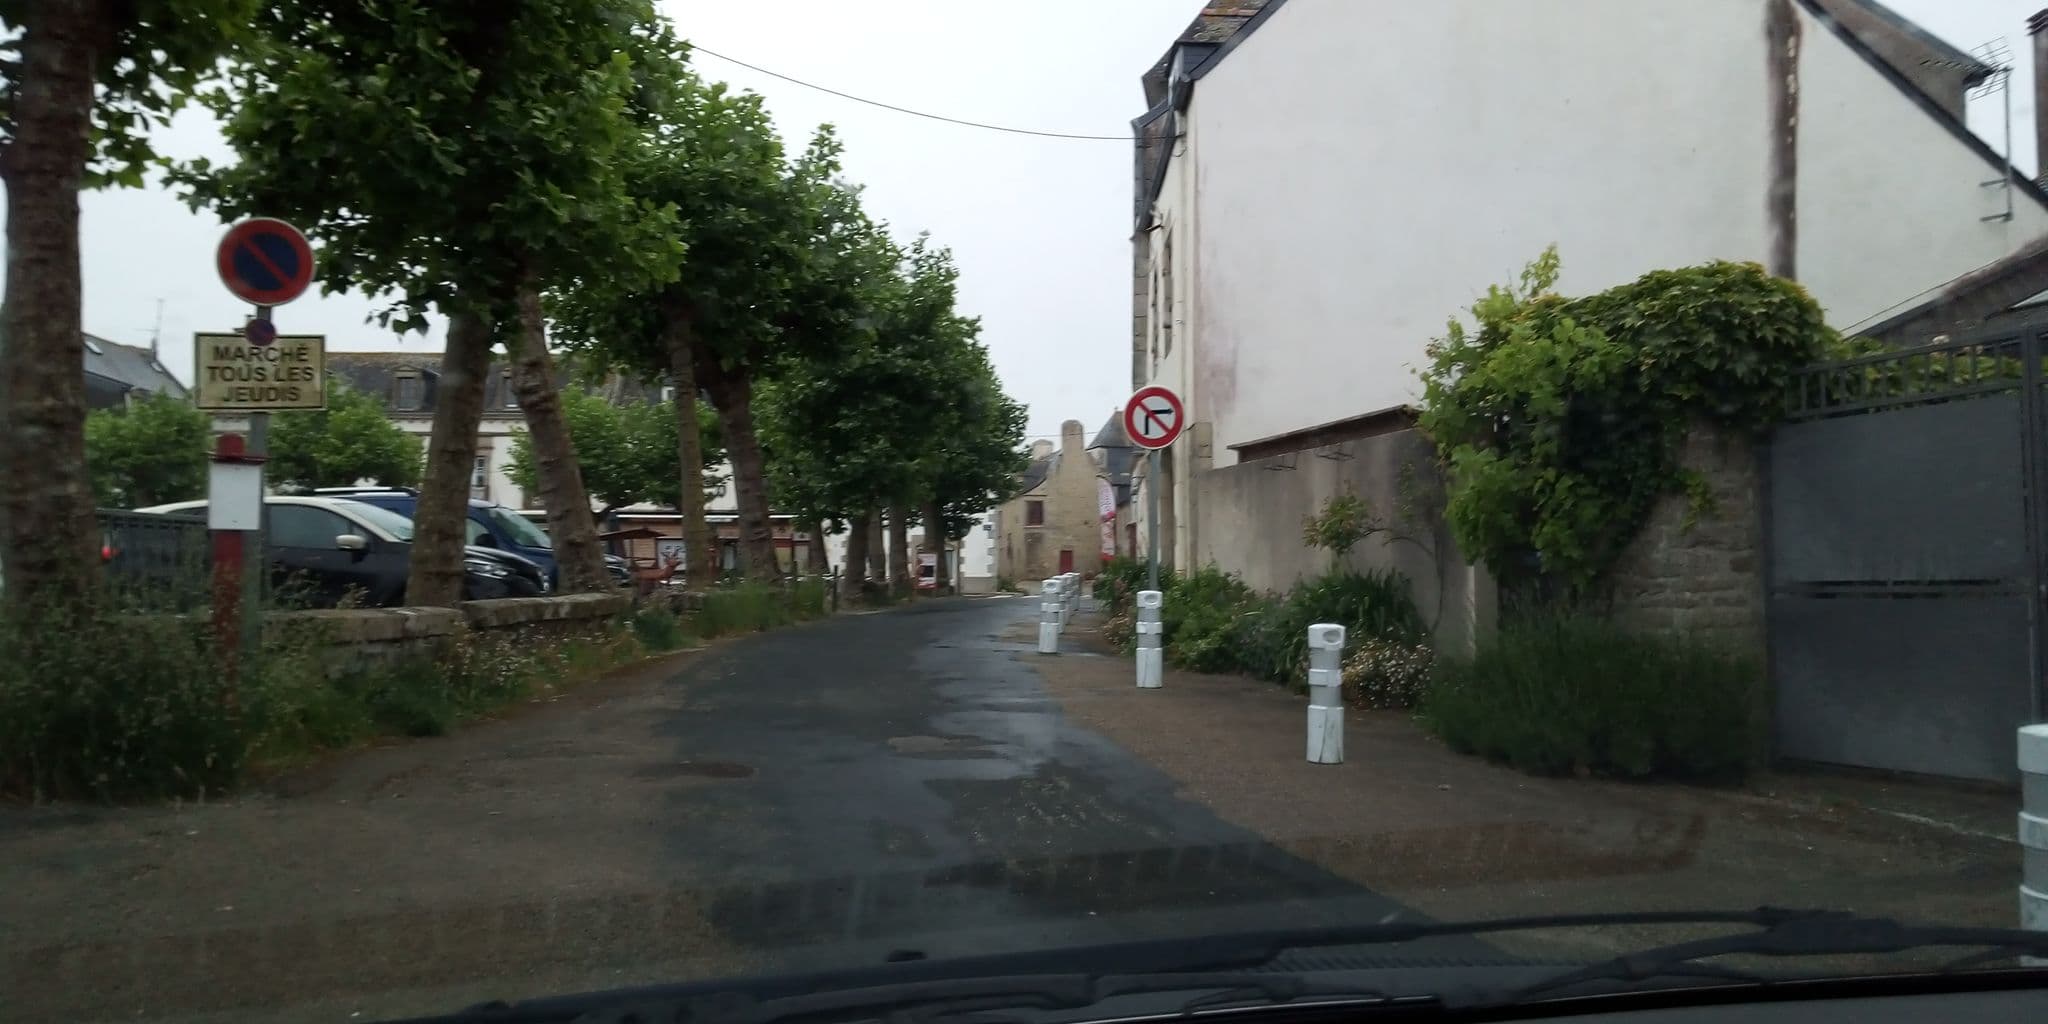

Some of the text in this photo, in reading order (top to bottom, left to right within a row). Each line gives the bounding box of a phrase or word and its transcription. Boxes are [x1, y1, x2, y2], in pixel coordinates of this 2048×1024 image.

[207, 366, 314, 382] TOUS LES
[222, 386, 301, 402] JEUDIS
